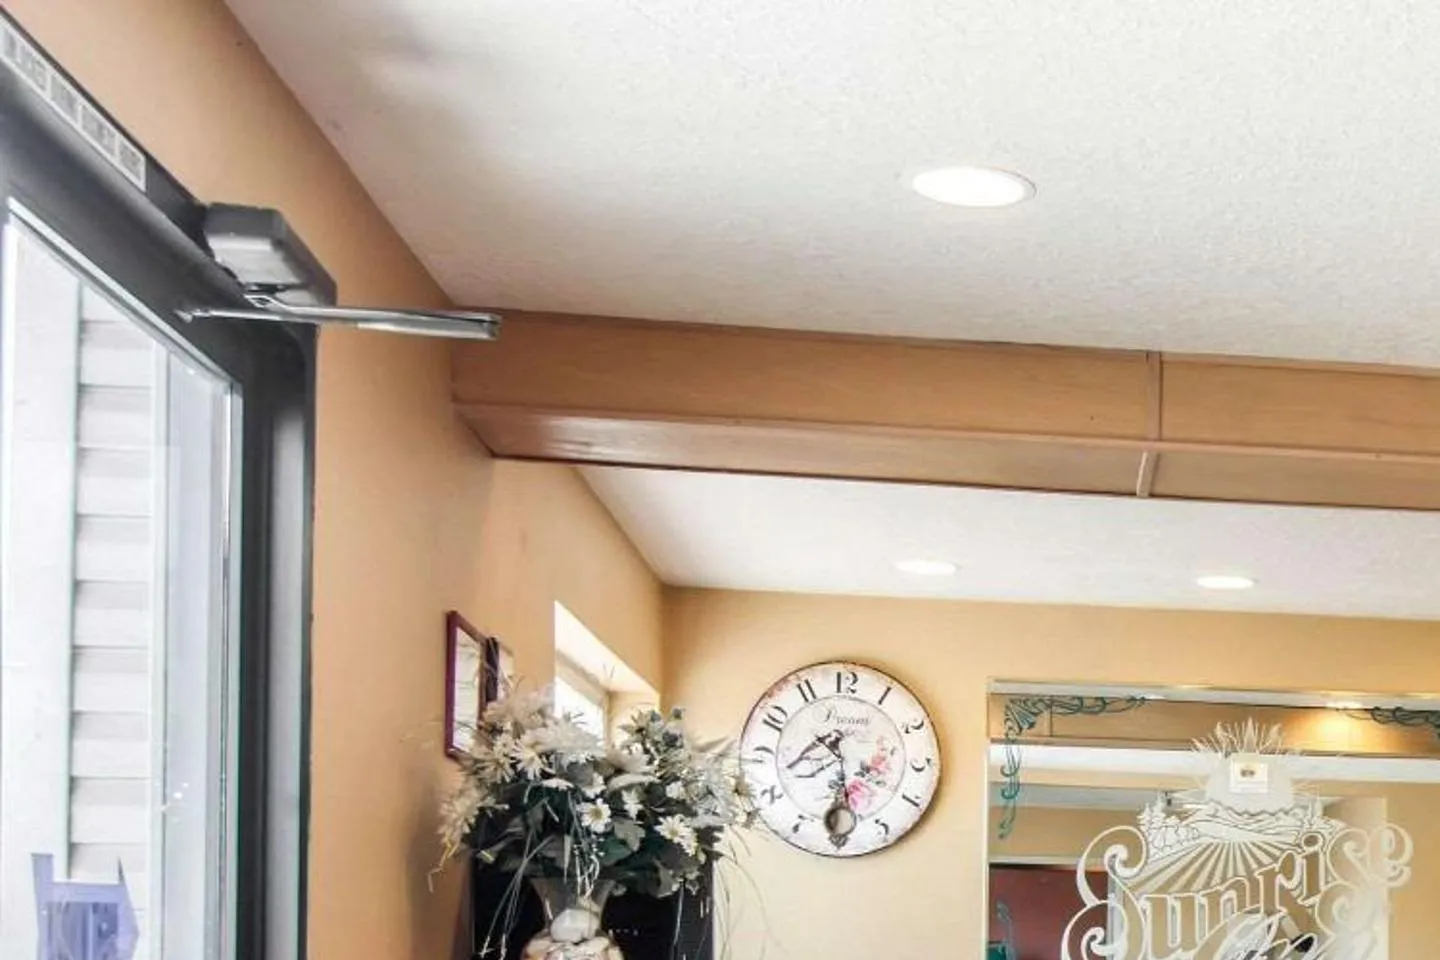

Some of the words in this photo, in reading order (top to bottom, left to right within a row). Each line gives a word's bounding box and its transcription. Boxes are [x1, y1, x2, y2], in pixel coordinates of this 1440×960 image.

[796, 679, 817, 703] 11
[836, 671, 859, 694] 12
[878, 686, 892, 705] 1
[762, 705, 788, 732] 10
[900, 717, 925, 734] 2
[909, 756, 932, 773] 3
